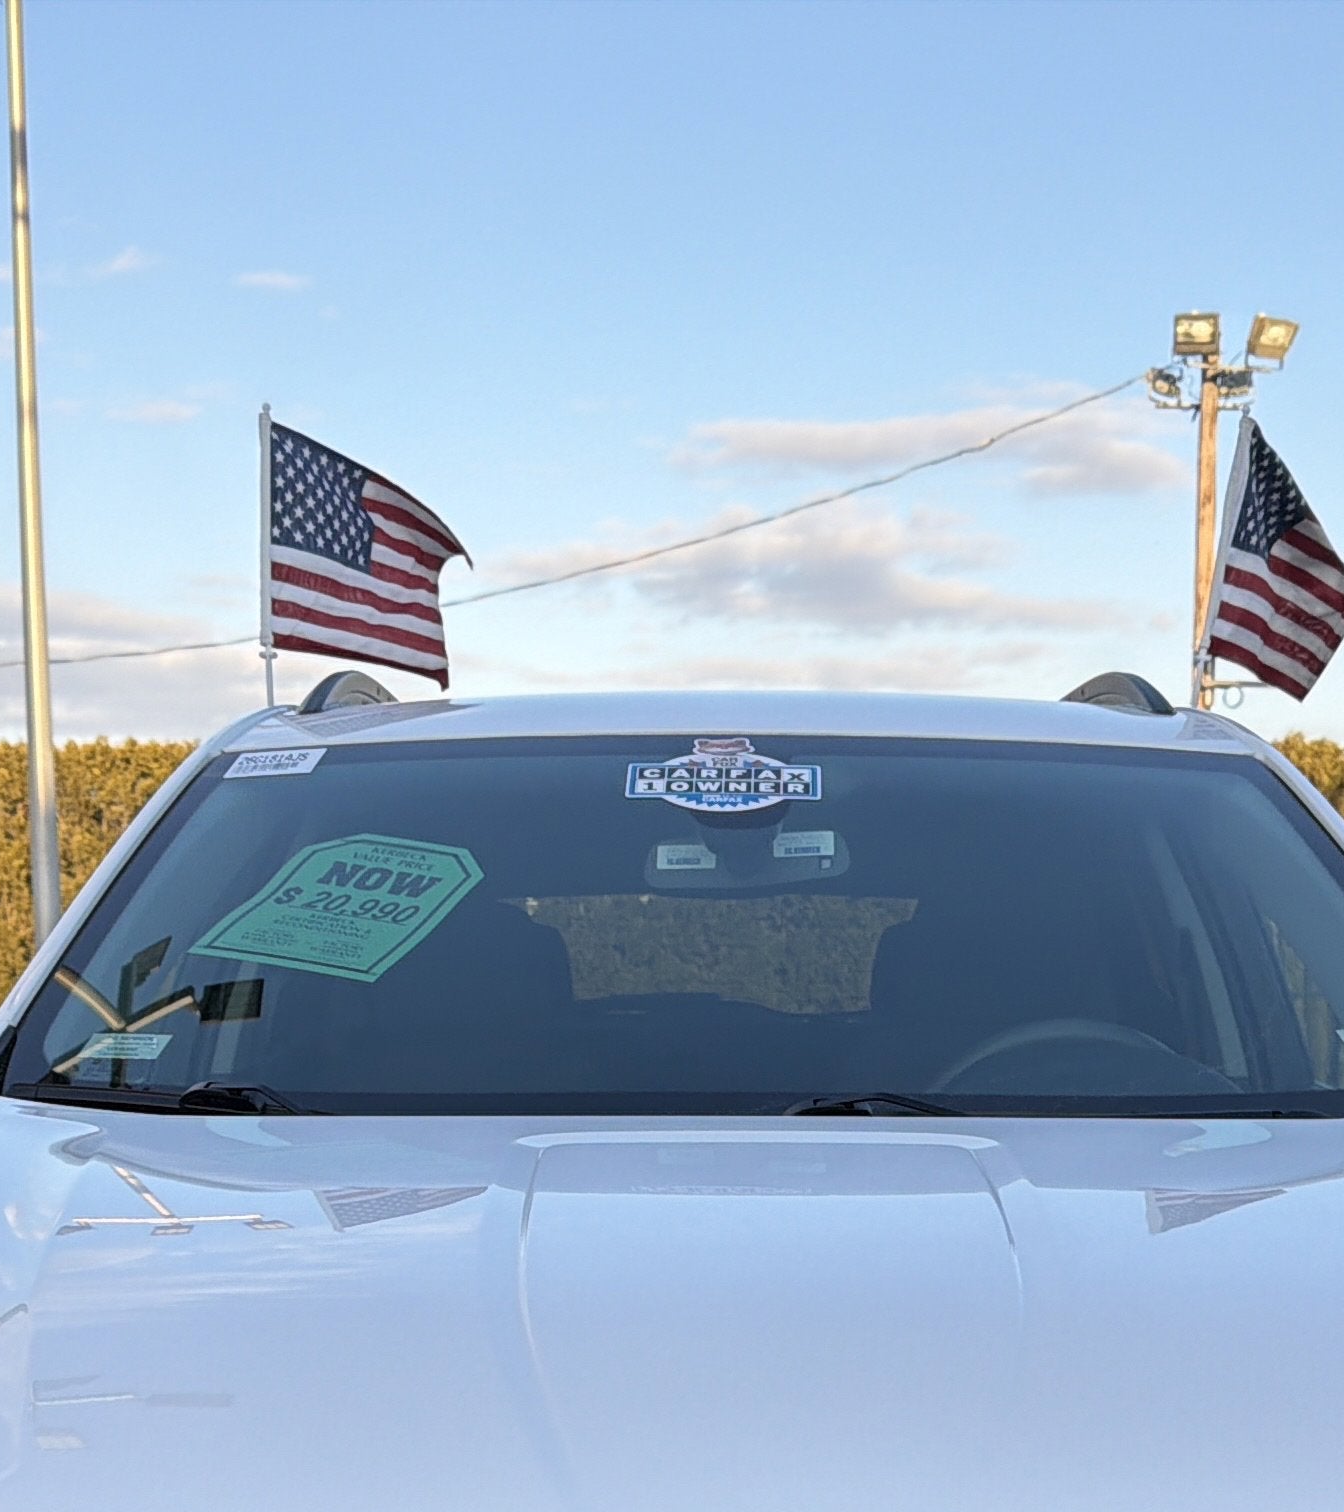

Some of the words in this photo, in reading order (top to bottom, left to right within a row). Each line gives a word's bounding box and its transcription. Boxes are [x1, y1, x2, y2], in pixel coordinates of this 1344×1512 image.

[642, 768, 806, 782] CARFAX
[643, 782, 657, 792] 1
[670, 781, 806, 794] OWNER
[397, 859, 435, 871] PRICE
[317, 860, 443, 899] NOW
[274, 886, 303, 905] $
[302, 889, 421, 924] 20,990
